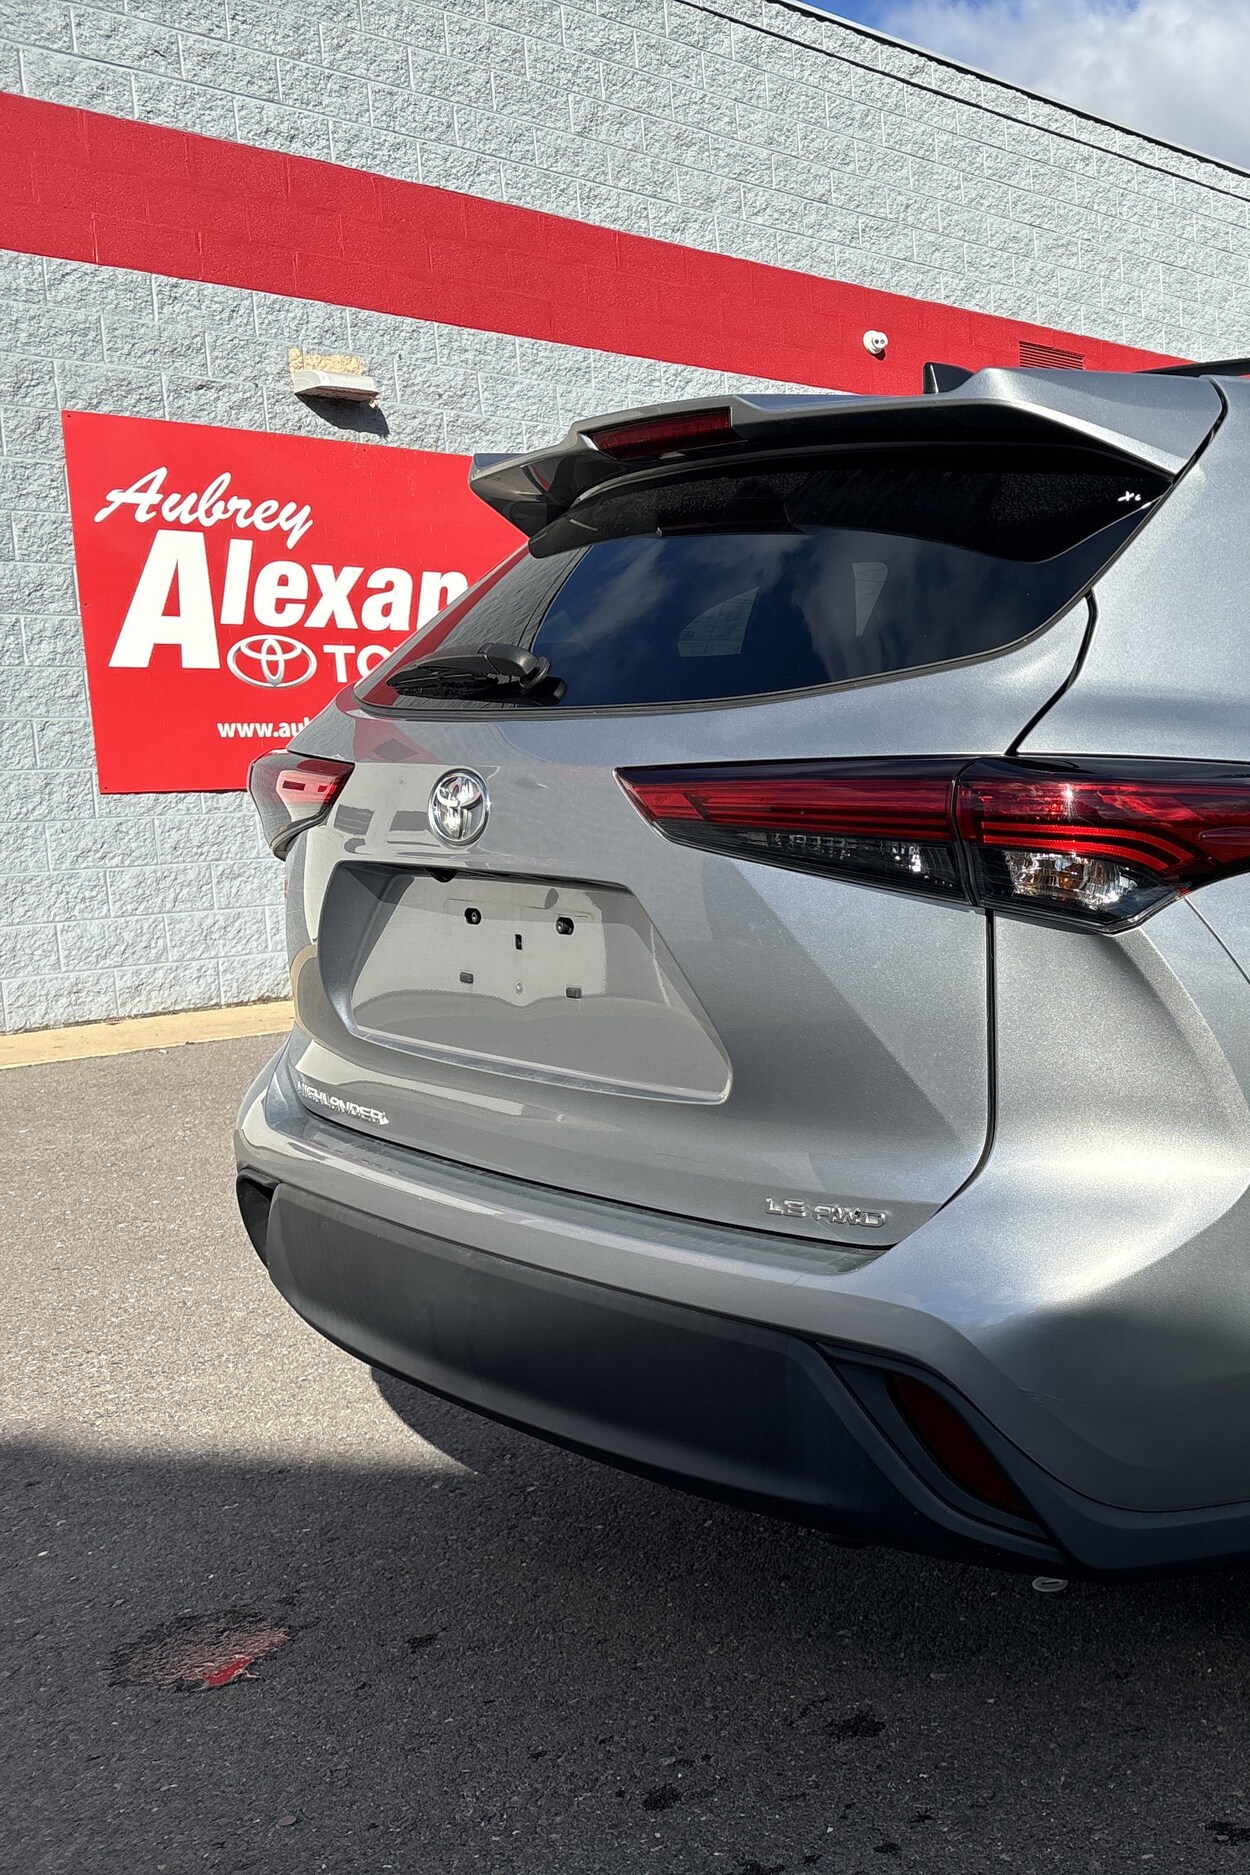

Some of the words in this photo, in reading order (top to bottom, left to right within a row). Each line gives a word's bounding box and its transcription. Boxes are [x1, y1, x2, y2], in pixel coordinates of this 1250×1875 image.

[93, 466, 314, 550] Aubrey
[107, 528, 469, 670] Alexan
[322, 644, 397, 683] TO
[297, 1080, 389, 1125] HIGHLANDER
[765, 1197, 807, 1218] LE
[814, 1203, 886, 1228] AWD
